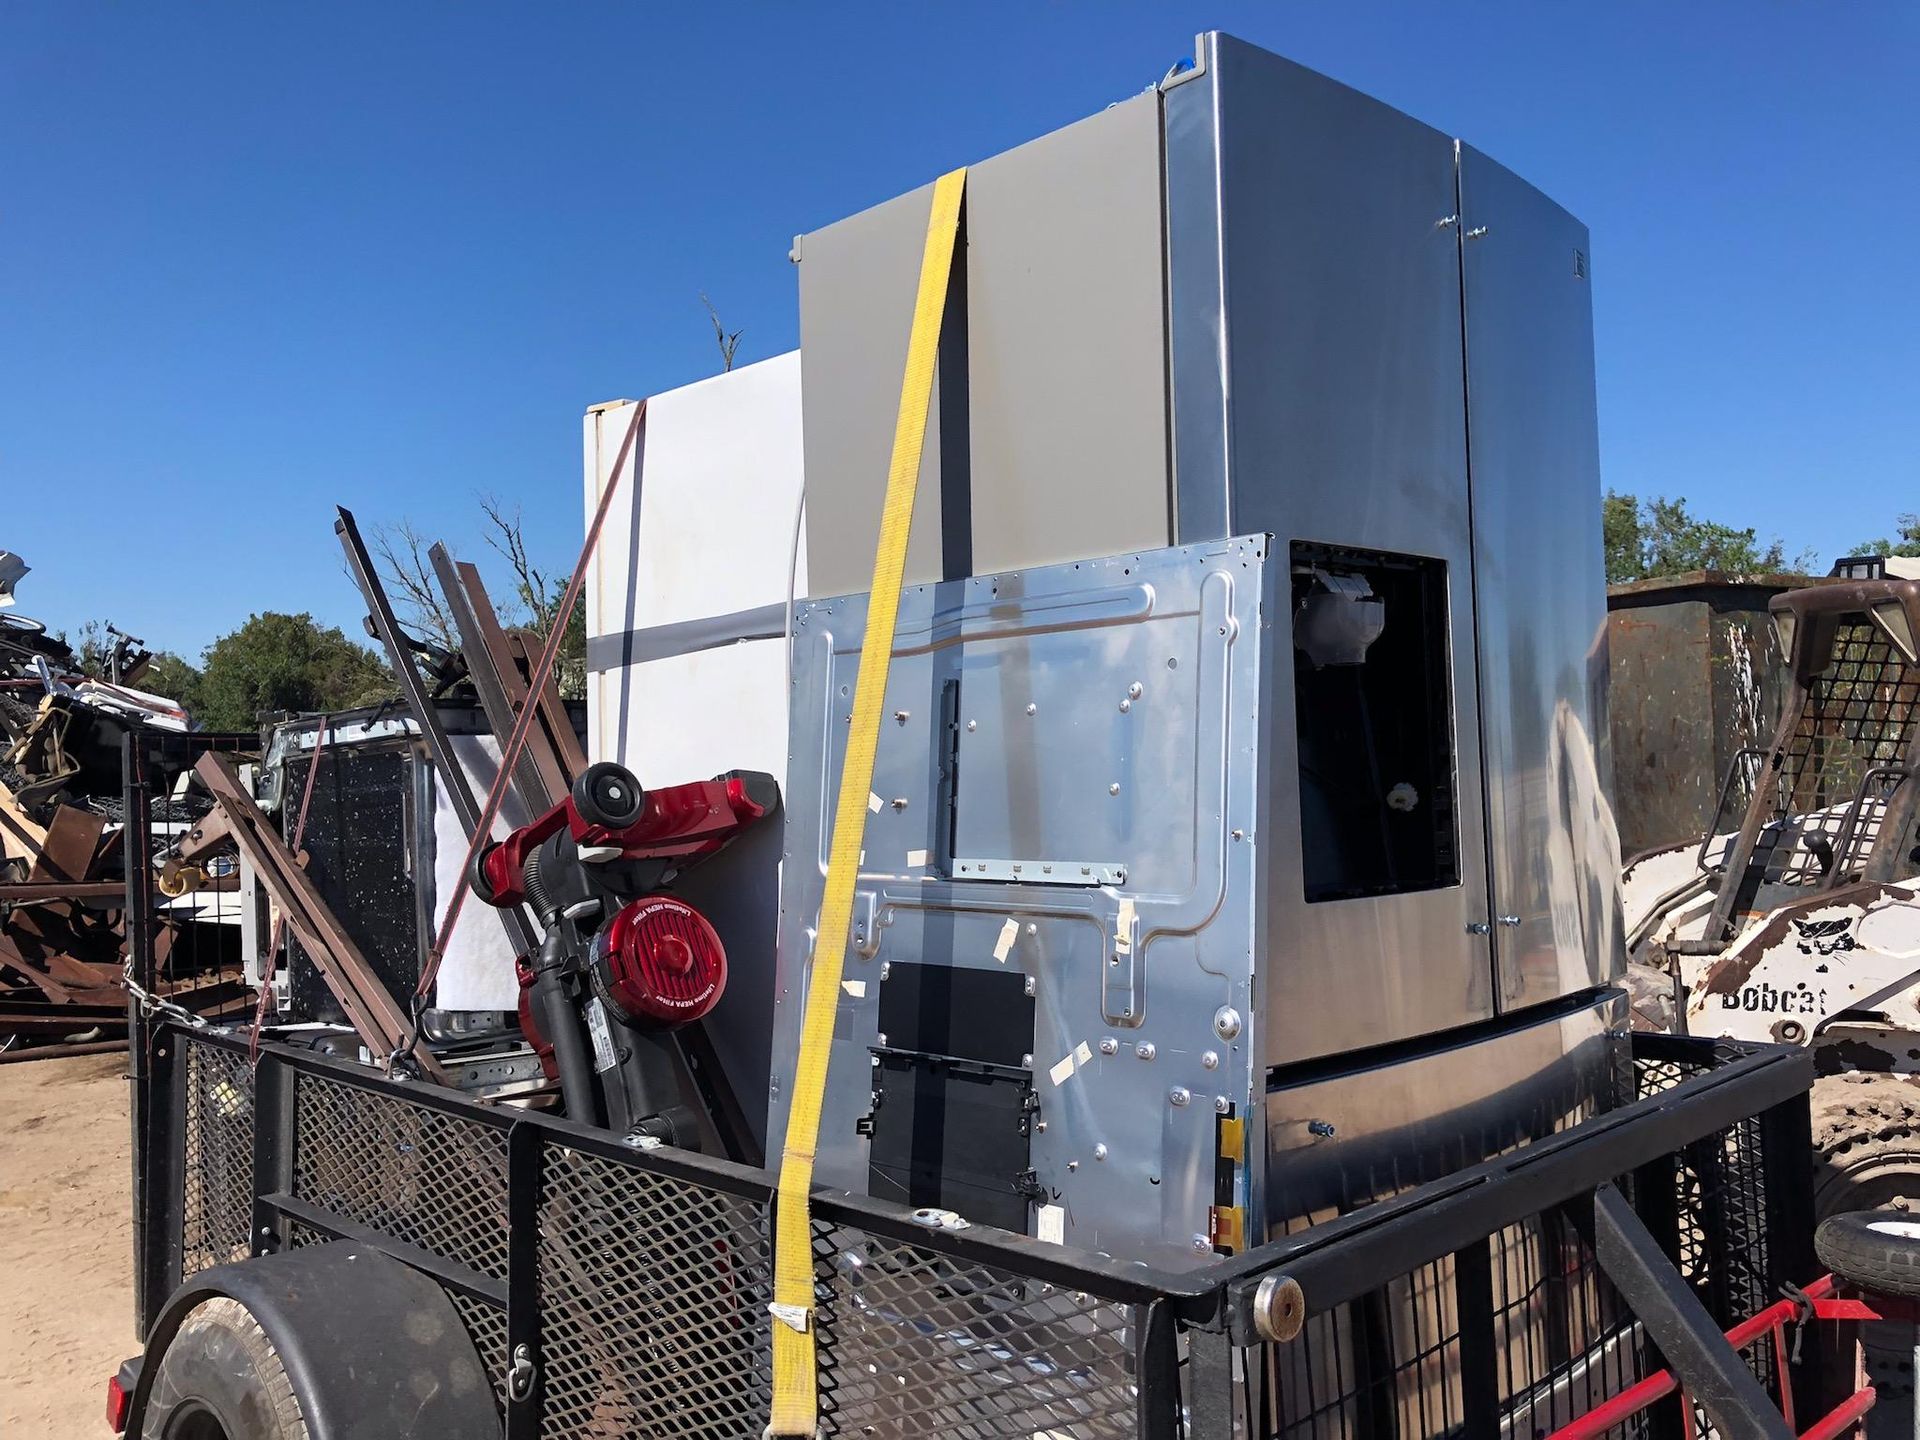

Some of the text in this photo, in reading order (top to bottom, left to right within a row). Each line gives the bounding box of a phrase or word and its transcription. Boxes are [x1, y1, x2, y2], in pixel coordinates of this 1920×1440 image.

[632, 903, 691, 926] Lifetime HEPA Filter
[655, 983, 715, 1008] Lifetime HEPA Filter
